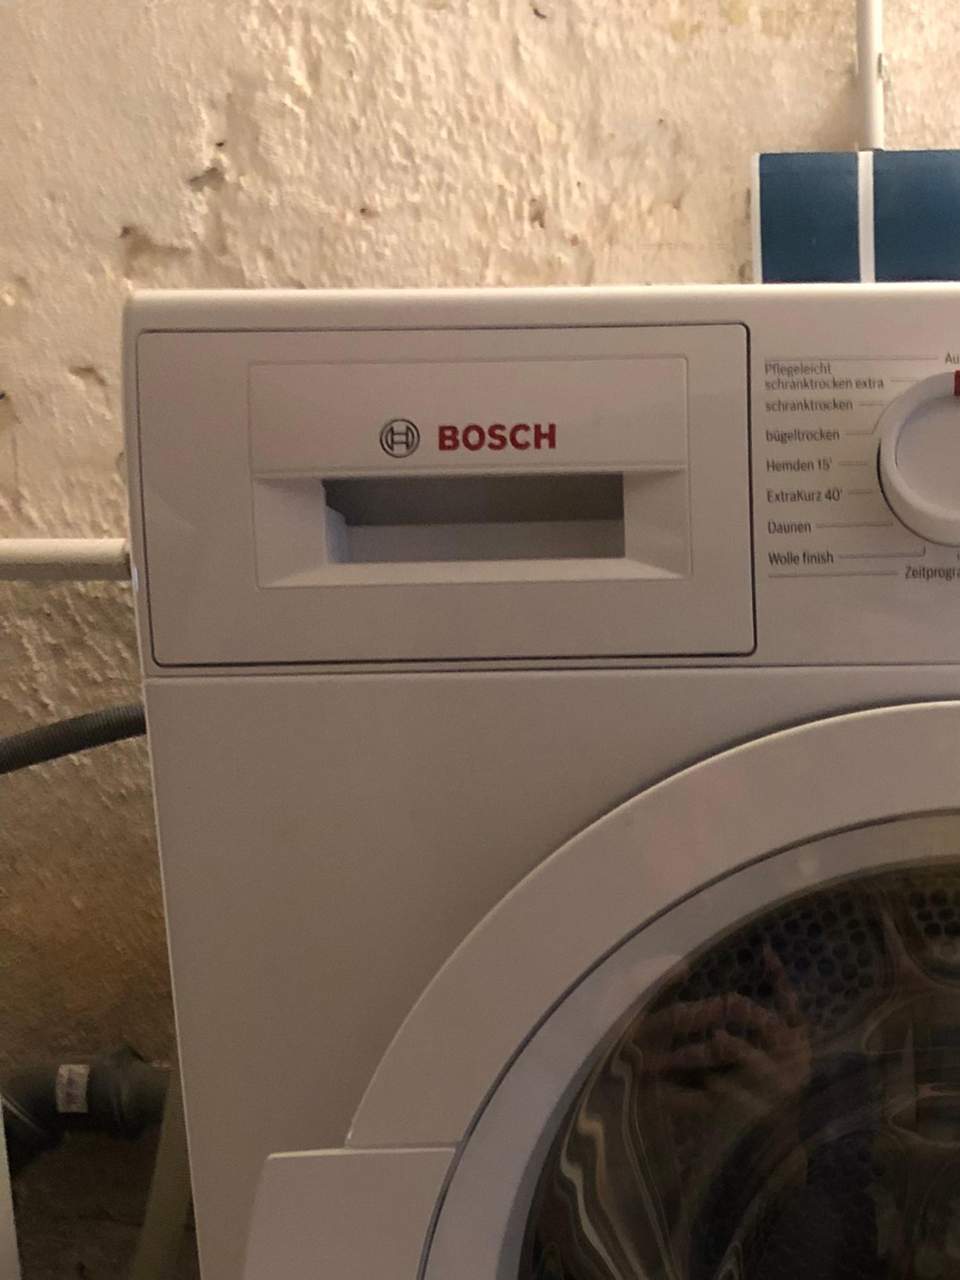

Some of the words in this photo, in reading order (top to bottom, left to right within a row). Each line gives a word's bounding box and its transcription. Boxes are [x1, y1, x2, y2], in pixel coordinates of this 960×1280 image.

[764, 361, 831, 377] Pflegeleicht
[764, 377, 853, 391] schranktrocken
[855, 378, 884, 390] extra
[765, 399, 853, 412] schranktrocken
[438, 423, 557, 451] BOSCH
[766, 459, 815, 472] Hemden
[768, 520, 812, 534] Daunen
[768, 551, 800, 565] Wolle
[802, 550, 834, 564] finish
